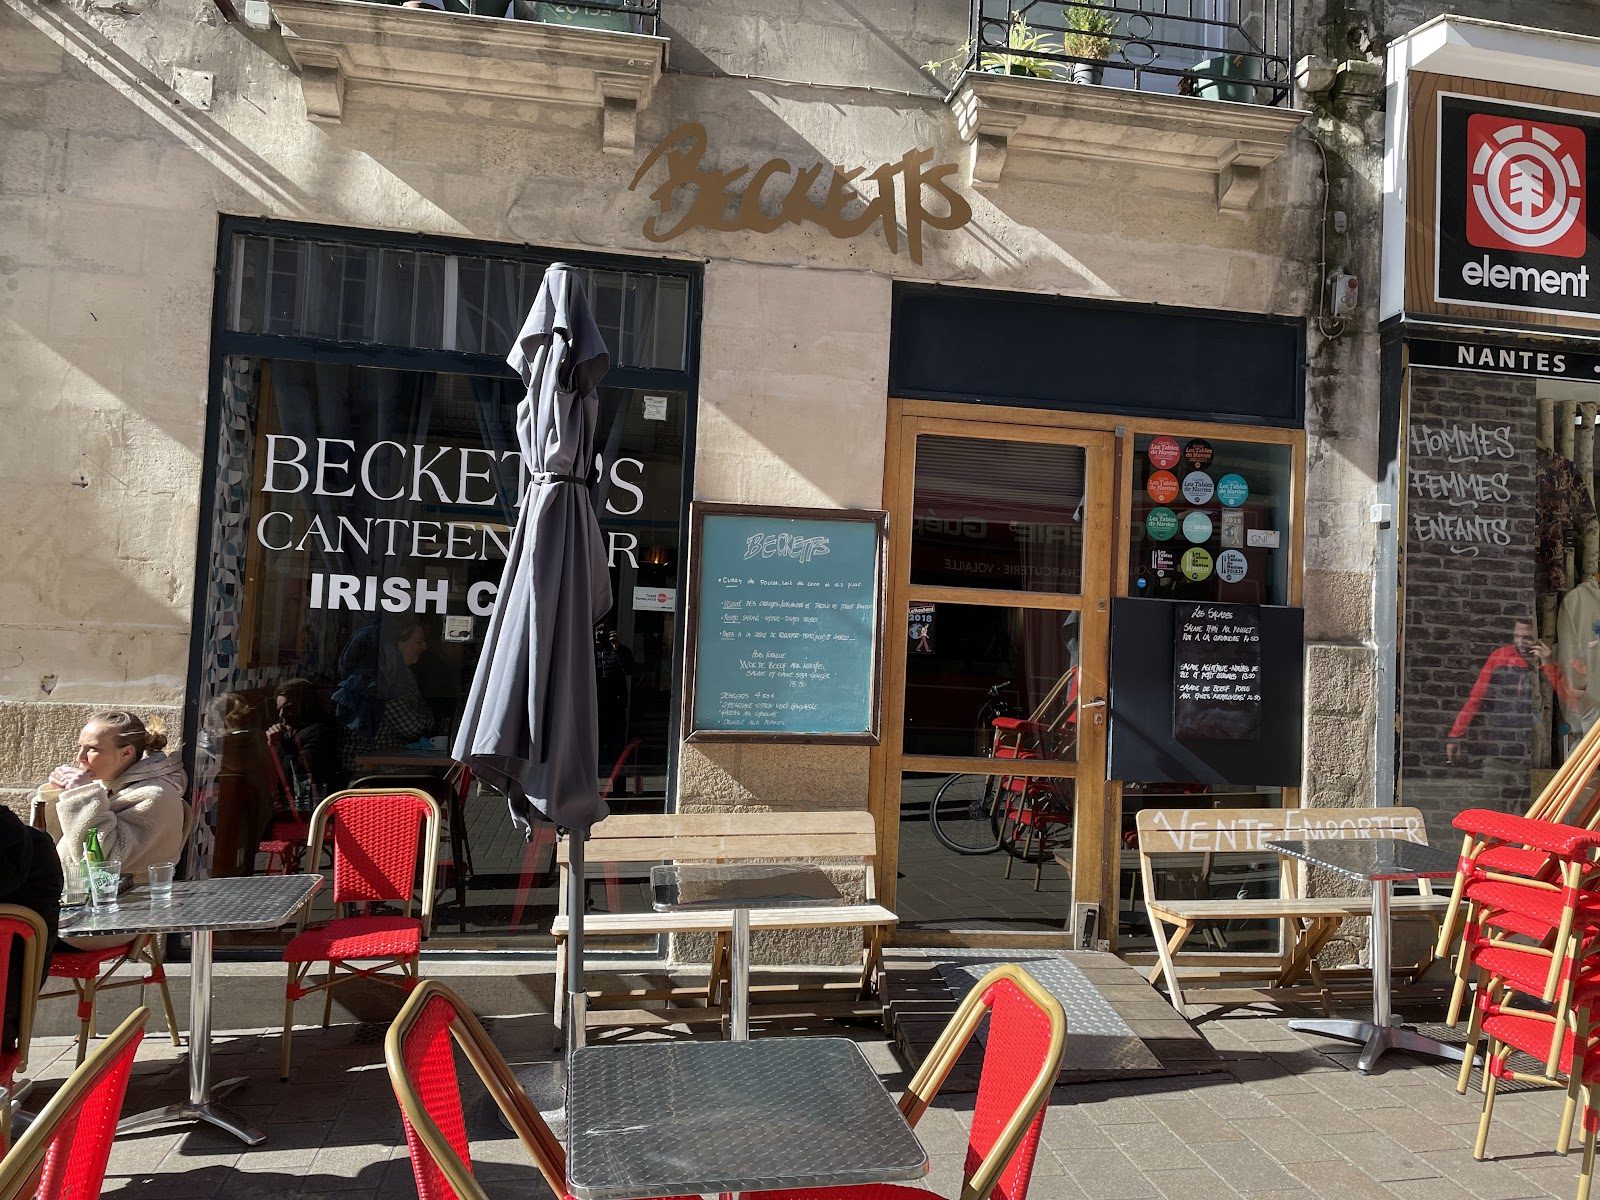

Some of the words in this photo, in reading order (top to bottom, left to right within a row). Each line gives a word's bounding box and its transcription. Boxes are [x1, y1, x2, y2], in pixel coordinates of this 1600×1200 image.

[1462, 254, 1590, 298] element
[1458, 345, 1566, 373] NANTES
[261, 433, 645, 516] BECKET'S
[1409, 466, 1511, 502] FEMMES
[1413, 511, 1511, 546] ENFANTS
[310, 573, 448, 614] IRISH
[908, 614, 933, 623] 2018
[1153, 810, 1274, 851] VENTE
